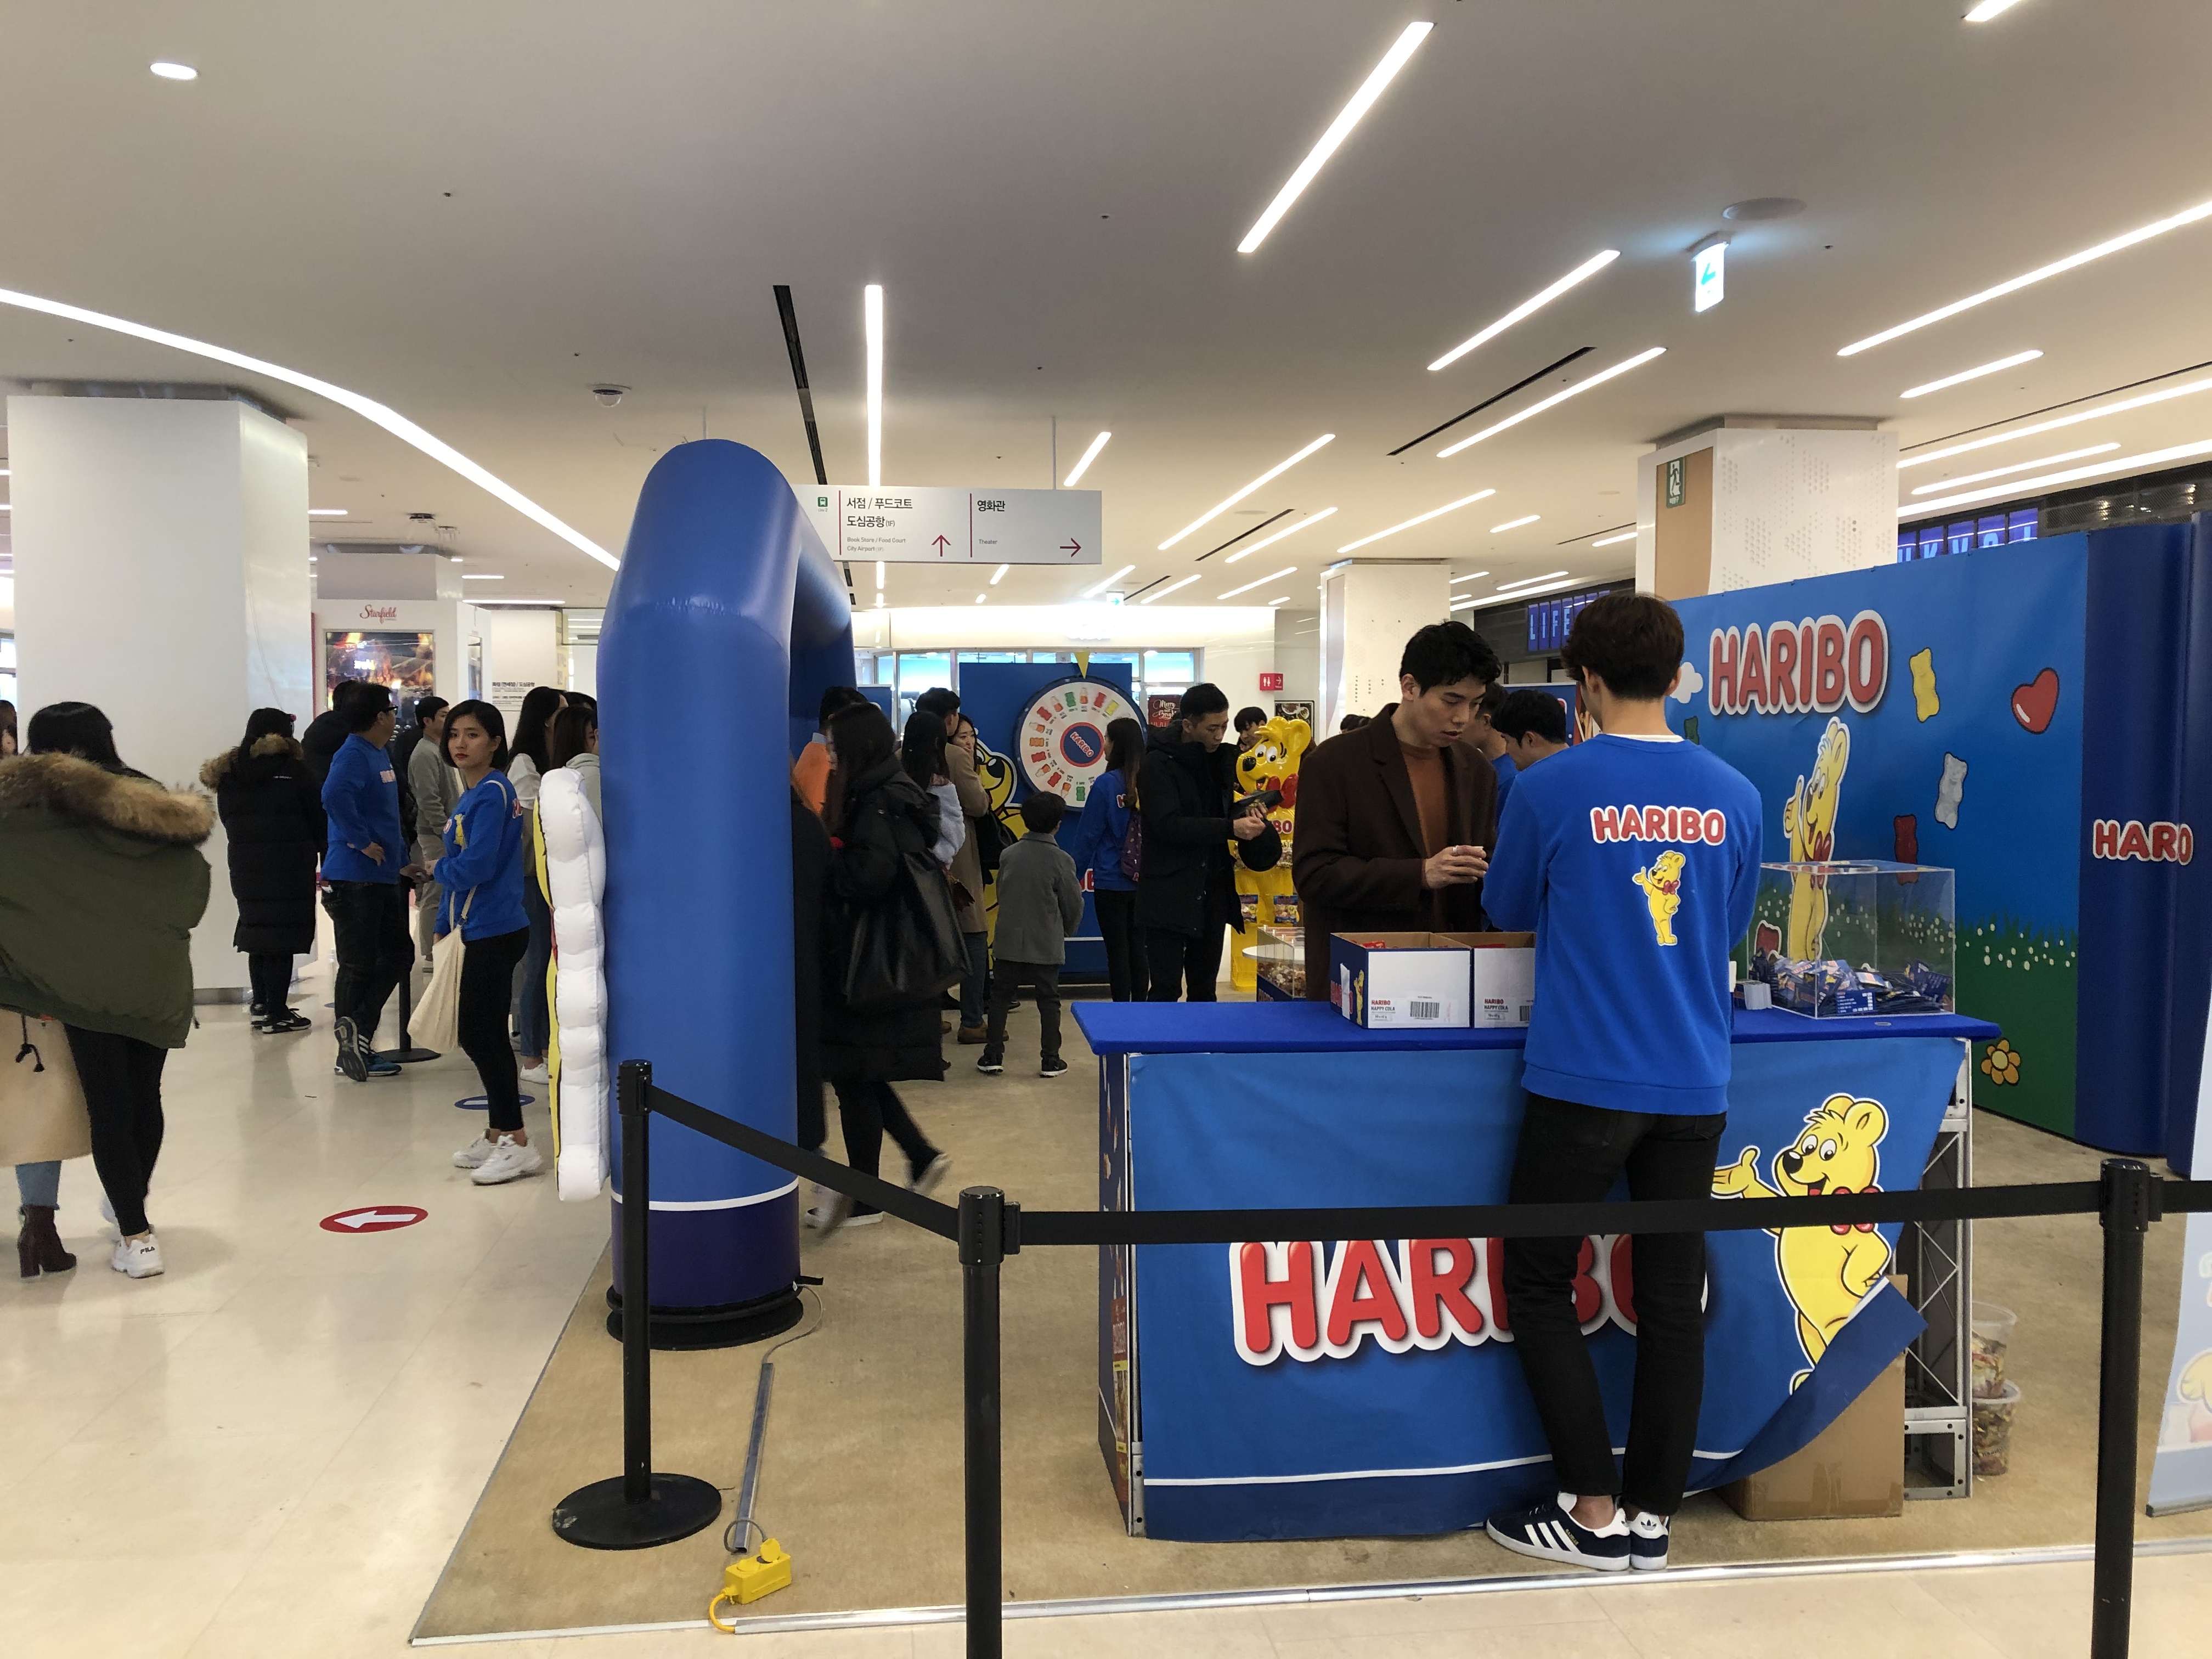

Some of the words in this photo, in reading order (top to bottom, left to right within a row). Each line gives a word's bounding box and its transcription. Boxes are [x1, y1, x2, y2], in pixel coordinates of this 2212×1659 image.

[847, 497, 866, 509] 서점
[868, 498, 872, 509] /
[874, 498, 913, 509] 푸드코트
[977, 500, 1006, 512] 영화관
[359, 604, 397, 624] Starfield
[1530, 608, 1570, 640] LIFE
[1708, 610, 1888, 715] HARIBO
[1070, 731, 1094, 758] HARIBO
[1590, 804, 1726, 846] HARIBO
[140, 1246, 155, 1255] FILA
